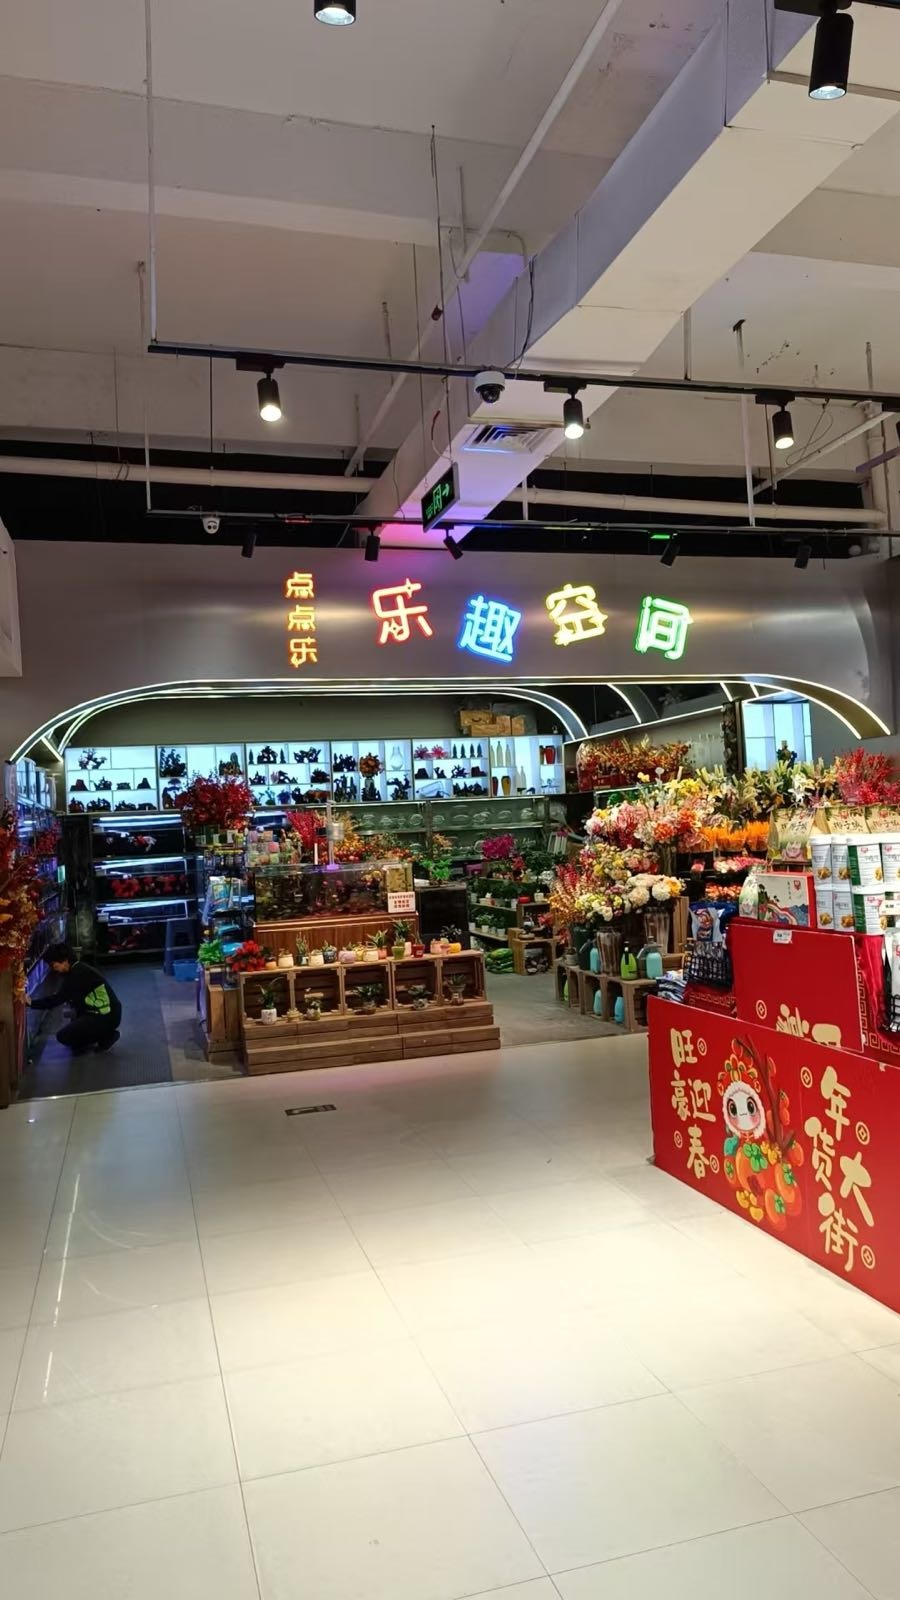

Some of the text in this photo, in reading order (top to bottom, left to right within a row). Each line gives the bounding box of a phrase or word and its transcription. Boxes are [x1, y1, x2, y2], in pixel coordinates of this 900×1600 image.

[286, 572, 318, 668] 点点乐
[372, 578, 693, 664] 乐趣空间
[804, 1066, 875, 1273] 年货大街
